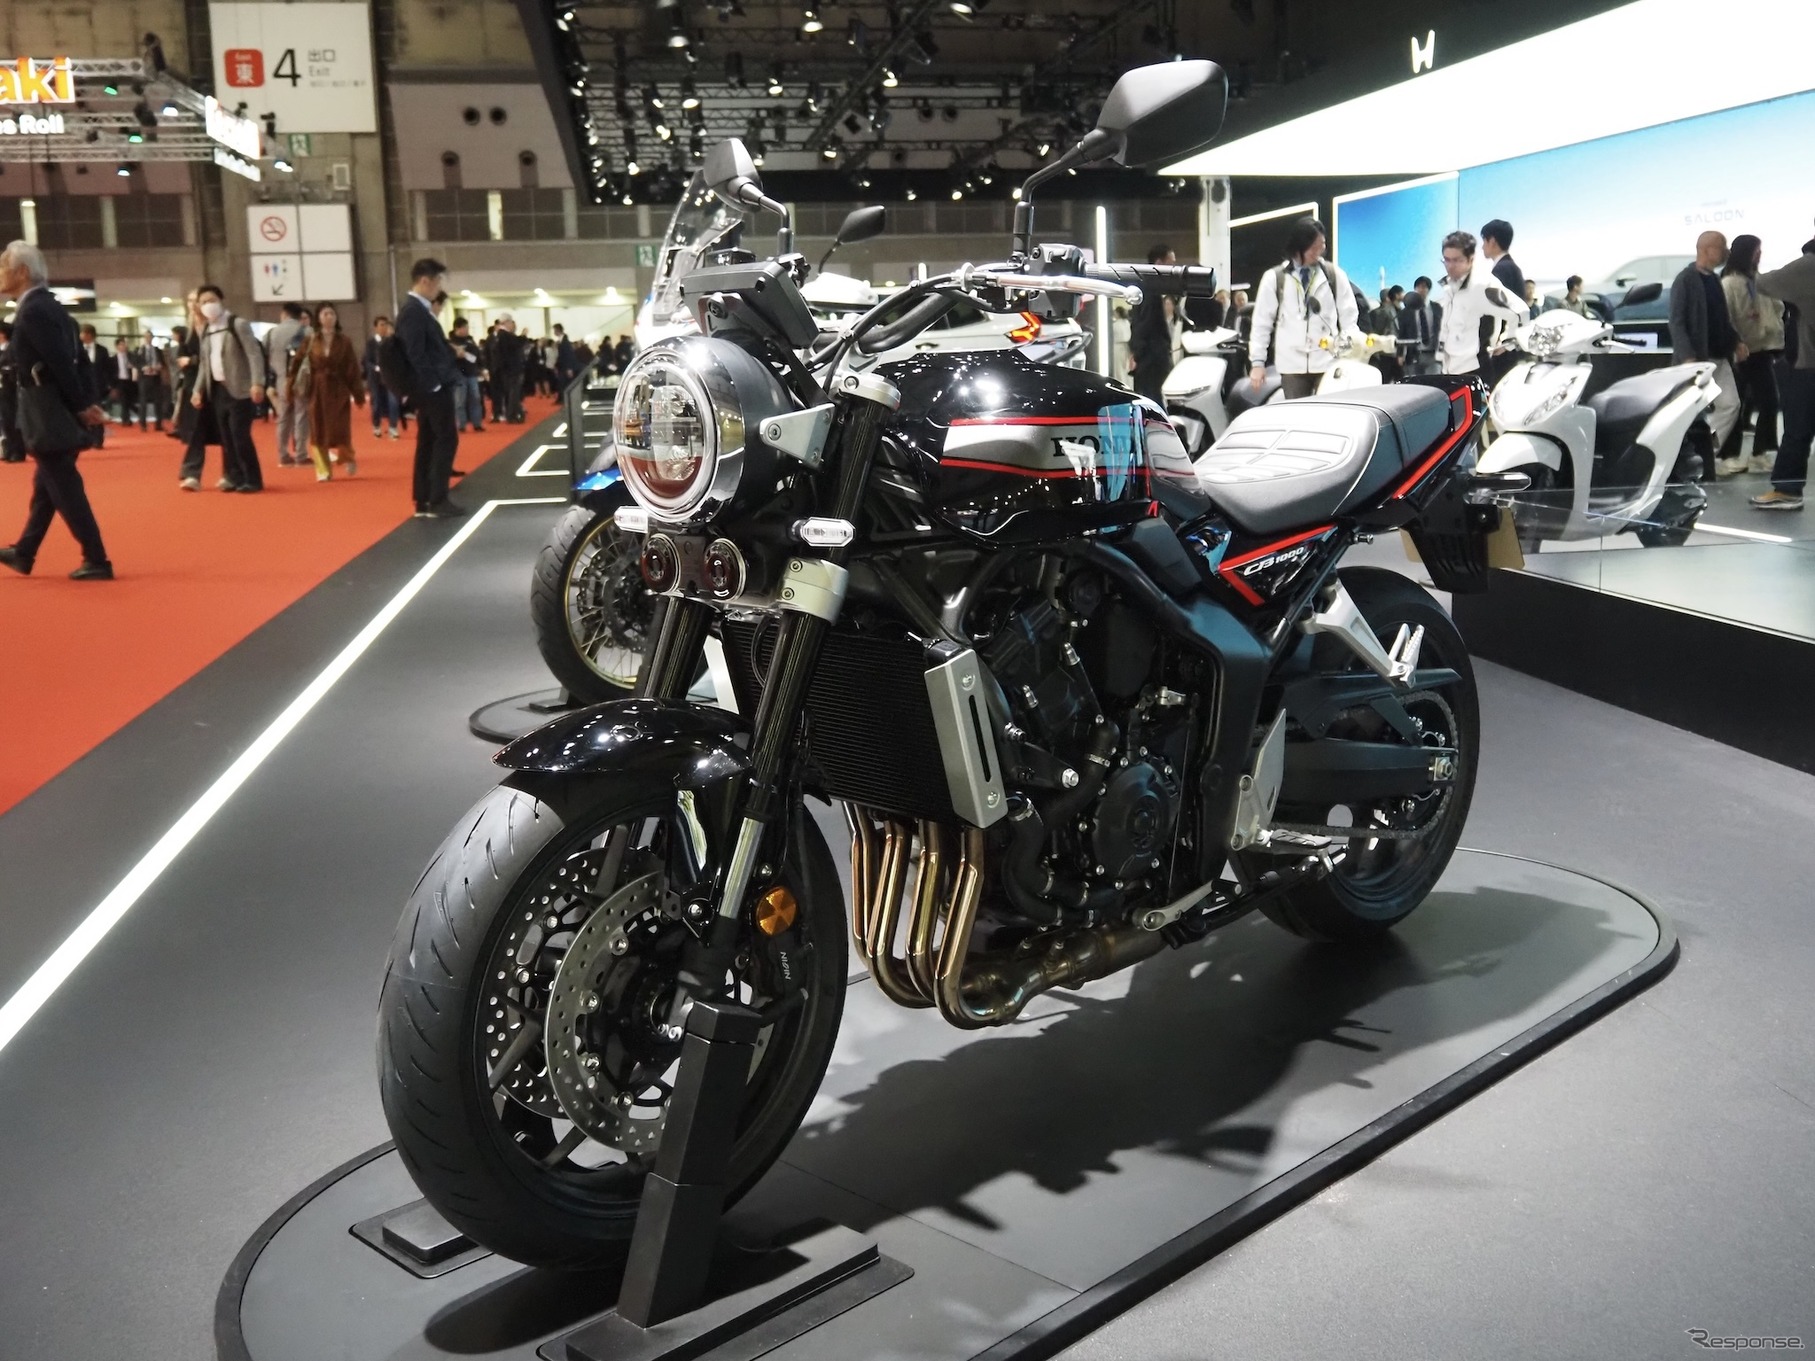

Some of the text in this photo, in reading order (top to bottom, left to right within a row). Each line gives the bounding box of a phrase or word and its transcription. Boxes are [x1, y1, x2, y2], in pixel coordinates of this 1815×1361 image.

[308, 49, 336, 62] 出口
[273, 48, 302, 87] 4
[19, 114, 65, 135] Roll
[1684, 209, 1745, 226] SALOON
